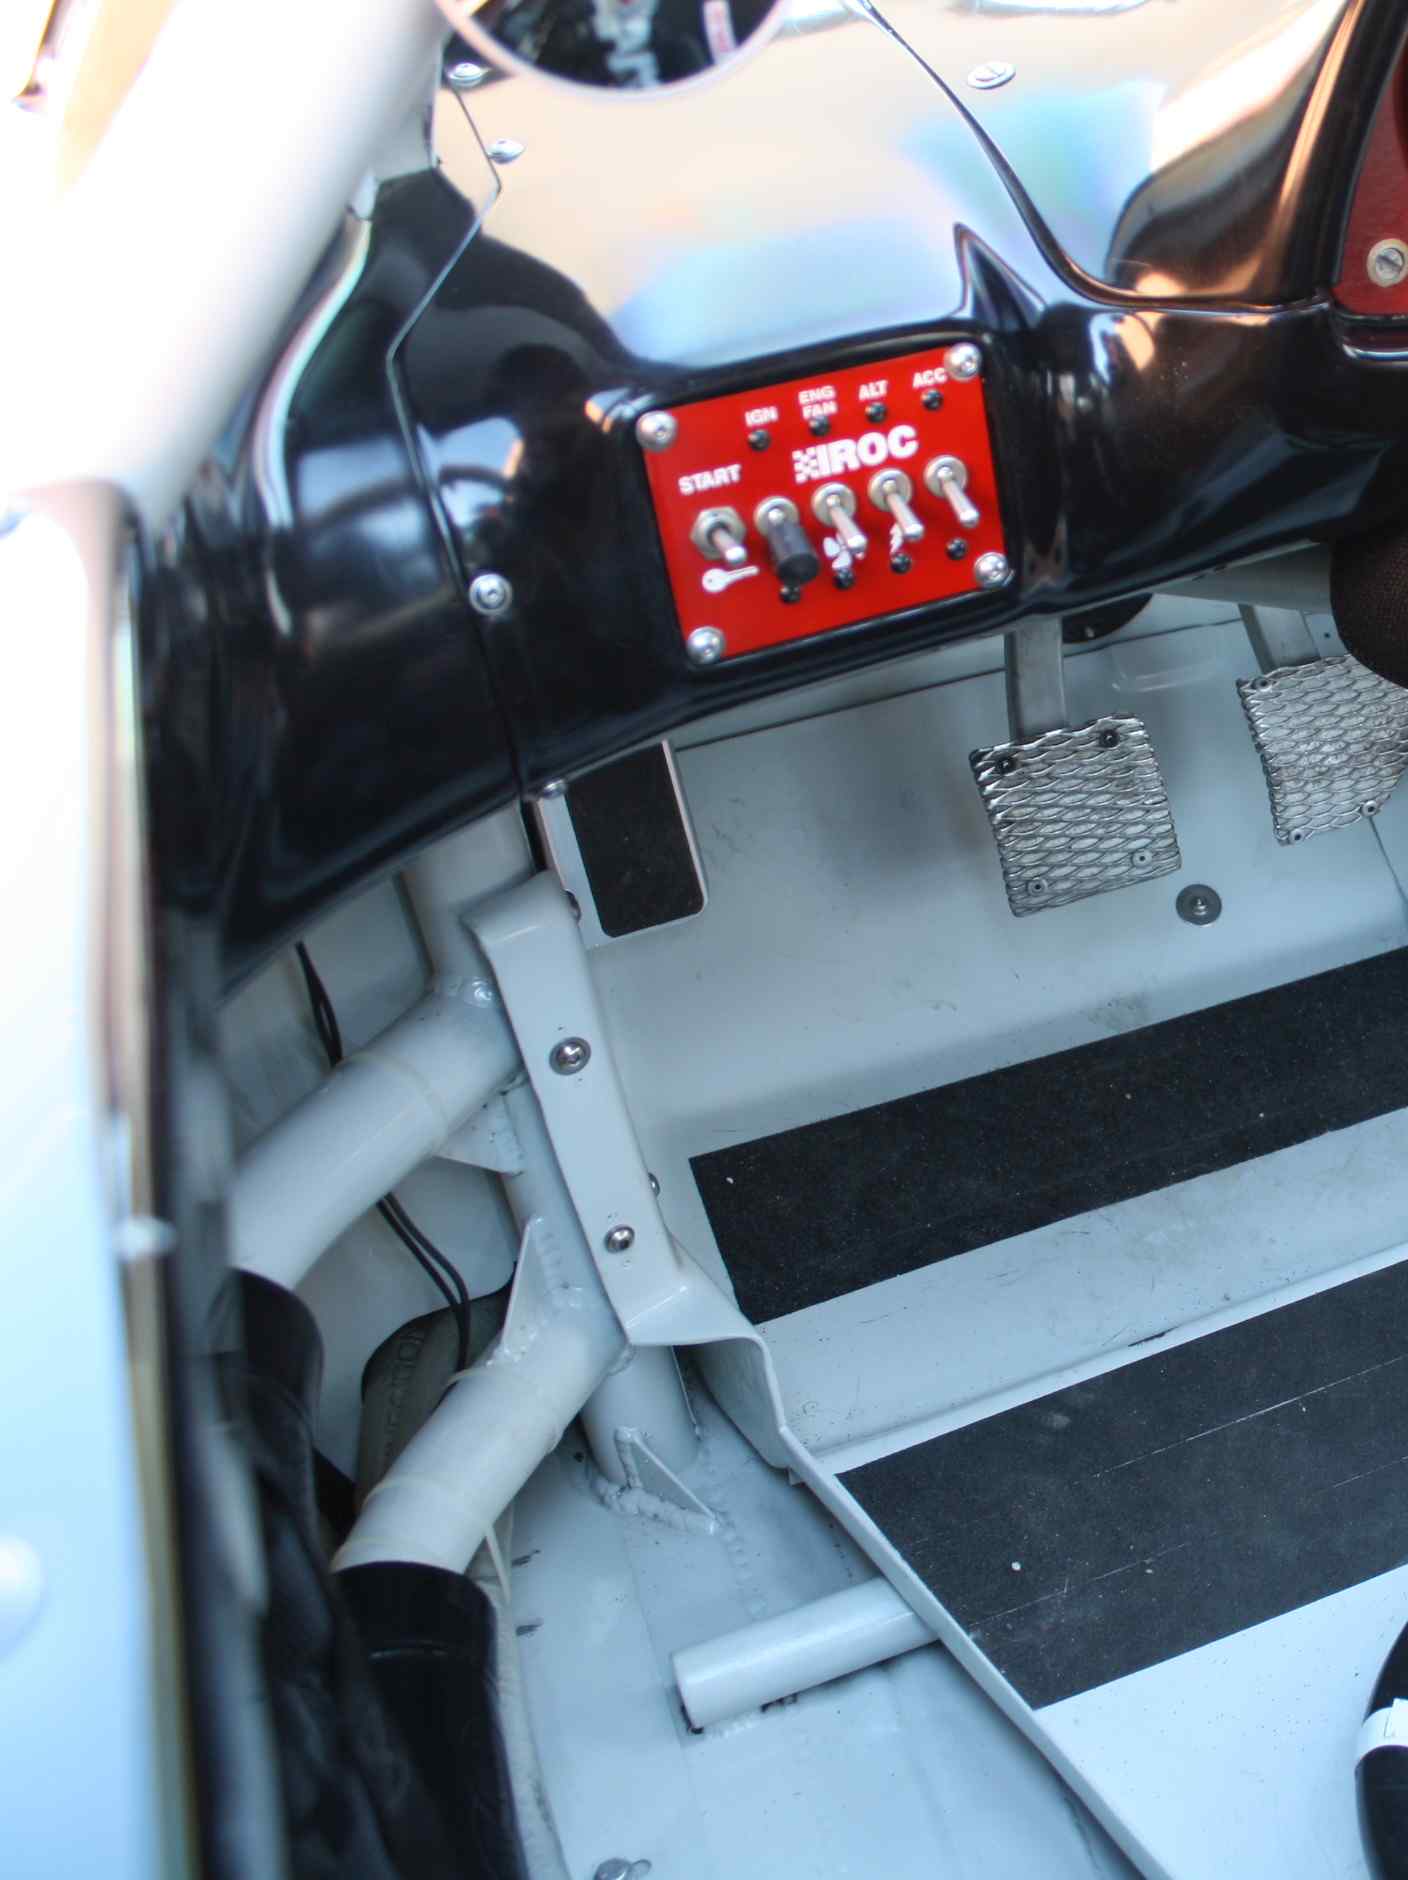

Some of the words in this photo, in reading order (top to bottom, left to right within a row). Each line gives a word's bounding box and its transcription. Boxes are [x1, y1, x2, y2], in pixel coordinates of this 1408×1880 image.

[912, 367, 948, 389] ACC
[798, 385, 837, 405] ENG
[858, 379, 889, 401] ALT
[744, 406, 779, 427] IGN
[801, 400, 838, 420] FAN
[812, 424, 919, 478] IROC
[678, 463, 742, 495] START
